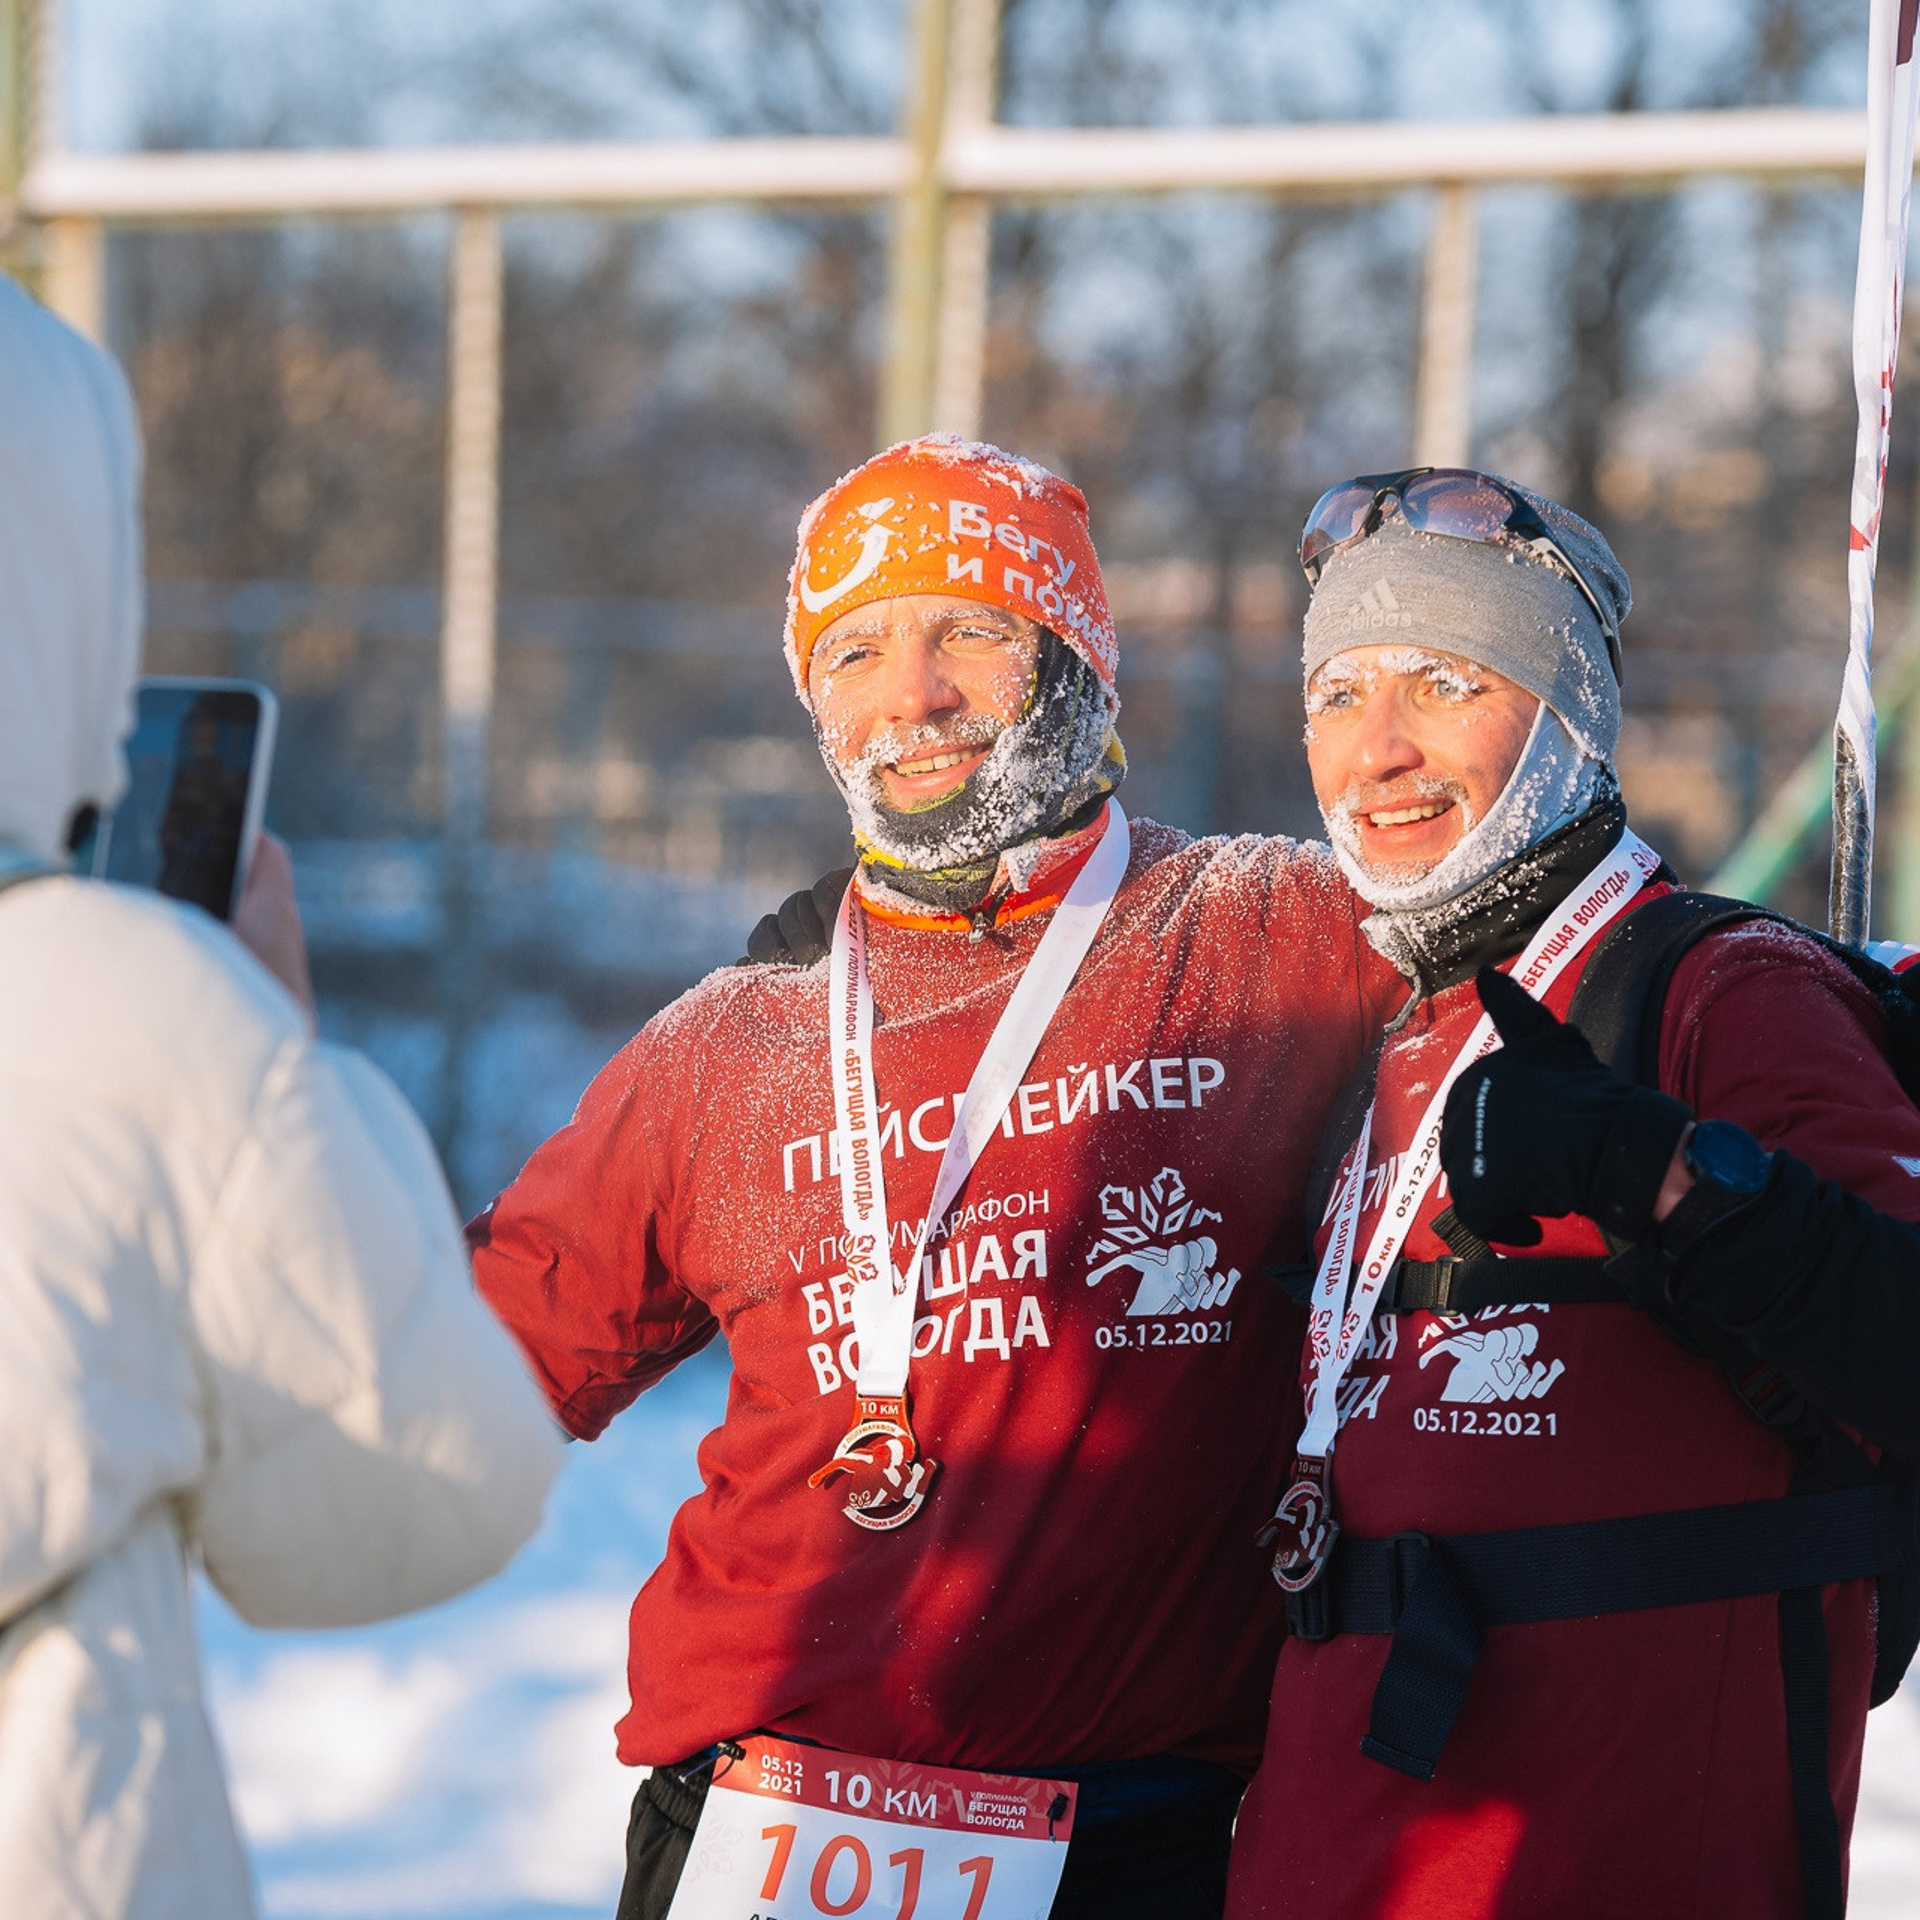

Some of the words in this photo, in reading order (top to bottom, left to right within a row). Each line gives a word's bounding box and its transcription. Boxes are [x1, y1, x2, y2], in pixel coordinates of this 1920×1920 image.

[948, 499, 1077, 587] Бегу
[946, 553, 983, 584] и
[1341, 608, 1412, 632] adidas
[845, 955, 859, 1041] ПОЛУМАРАФОН
[1361, 1260, 1382, 1295] 10
[807, 1295, 1051, 1396] ВООГДА
[1095, 1320, 1232, 1349] 05.12.2021
[861, 1402, 877, 1414] 10
[1413, 1407, 1557, 1436] 05.12.2021
[761, 1754, 804, 1777] 05.12
[758, 1772, 802, 1796] 2021
[825, 1770, 872, 1809] 10
[966, 1814, 1025, 1830] ВОЛОГДА
[968, 1801, 1027, 1816] БЕГУЩАЯ
[759, 1823, 994, 1920] 1011
